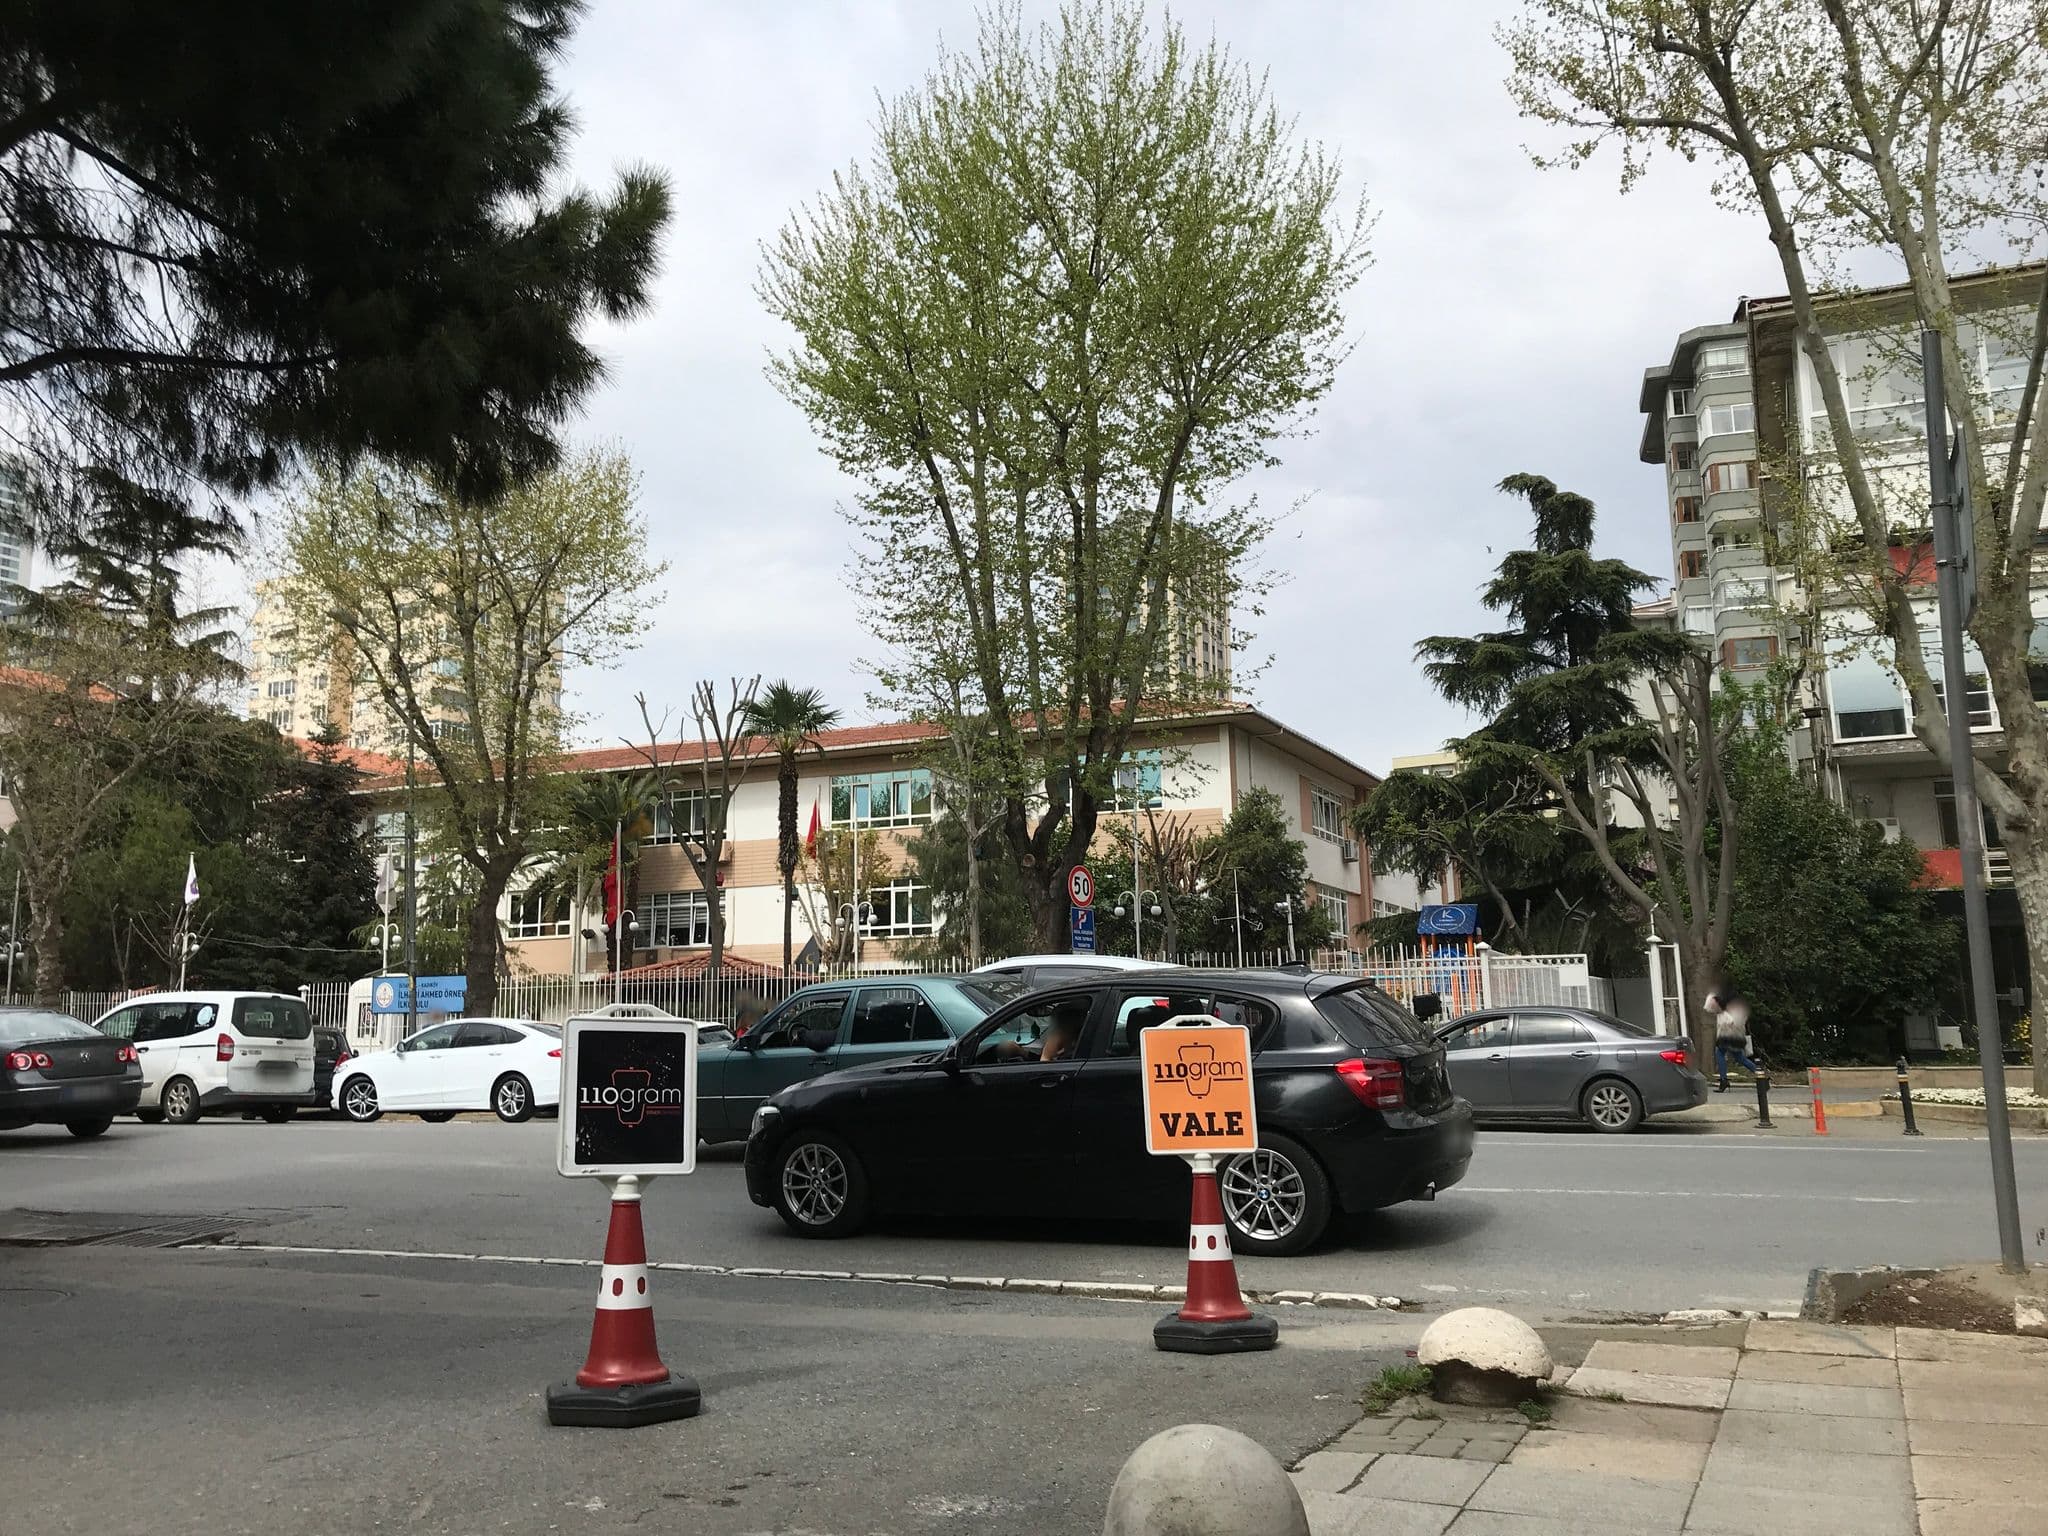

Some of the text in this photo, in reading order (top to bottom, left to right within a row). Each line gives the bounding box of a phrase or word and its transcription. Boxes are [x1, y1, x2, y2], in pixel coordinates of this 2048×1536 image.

[1074, 876, 1089, 897] 50
[420, 990, 443, 999] AHMED
[1154, 1061, 1244, 1081] 110gram
[580, 1086, 682, 1113] 110gram
[1160, 1111, 1244, 1137] VALE
